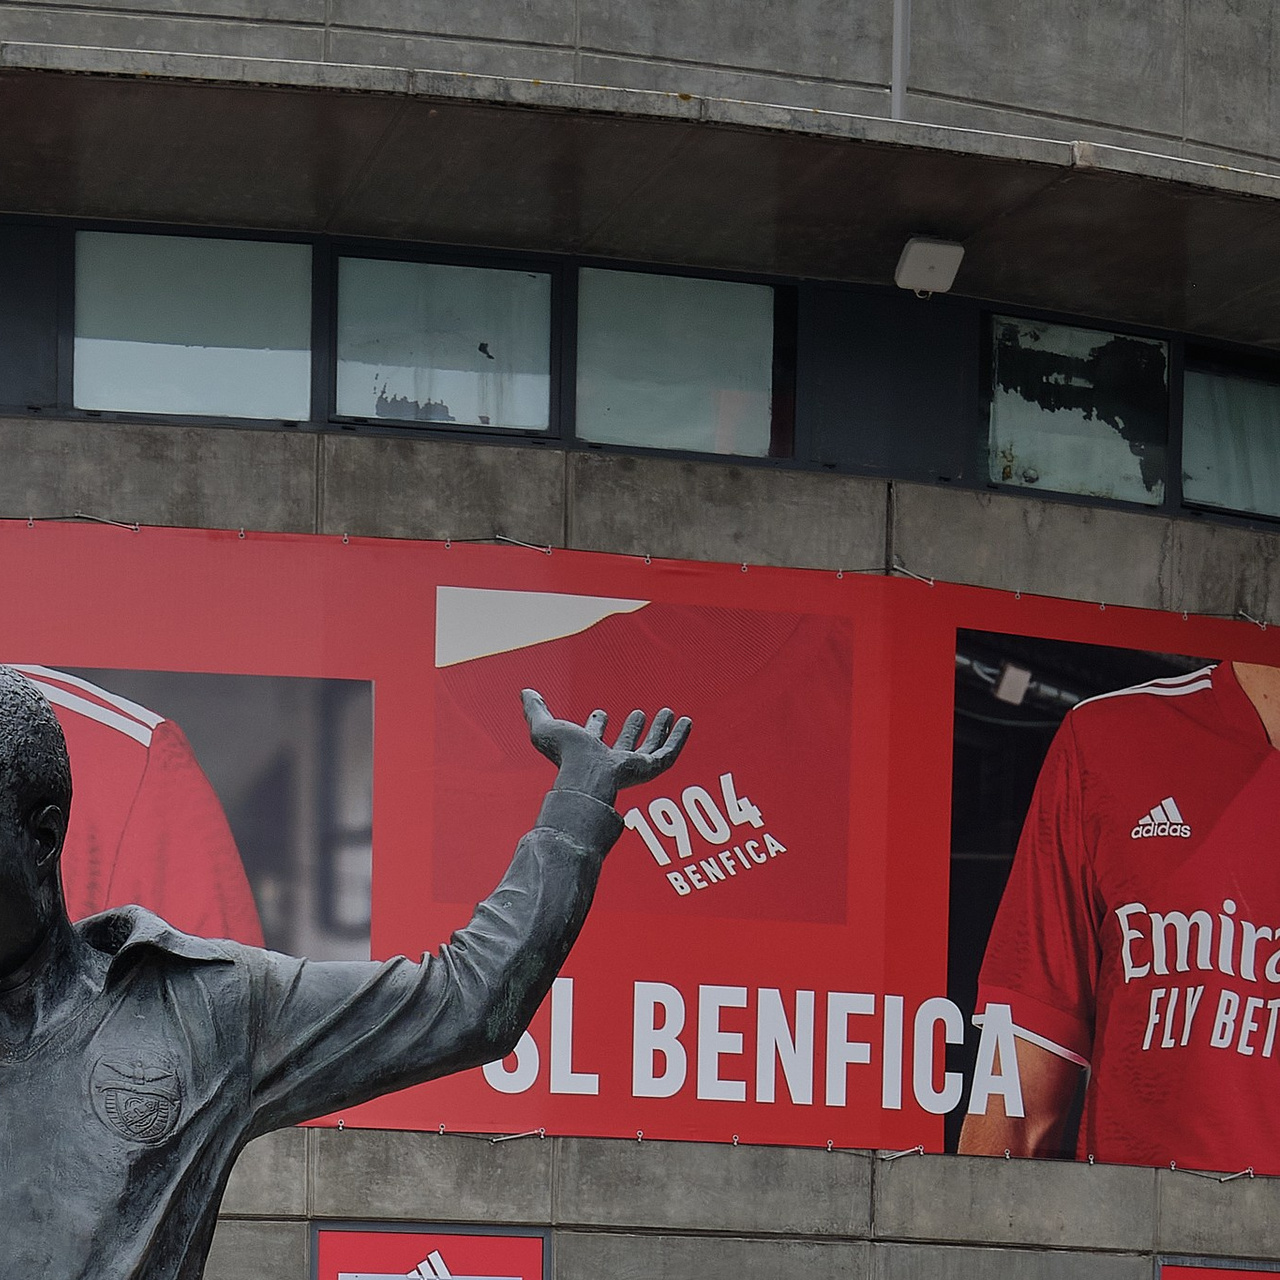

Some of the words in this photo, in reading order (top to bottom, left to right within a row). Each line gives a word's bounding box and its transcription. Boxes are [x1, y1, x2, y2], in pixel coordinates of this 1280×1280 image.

[623, 773, 764, 868] 1904
[1131, 821, 1191, 839] adidas
[666, 832, 787, 898] BENFICA
[632, 980, 1025, 1118] BENFICA
[1142, 985, 1204, 1050] FLY
